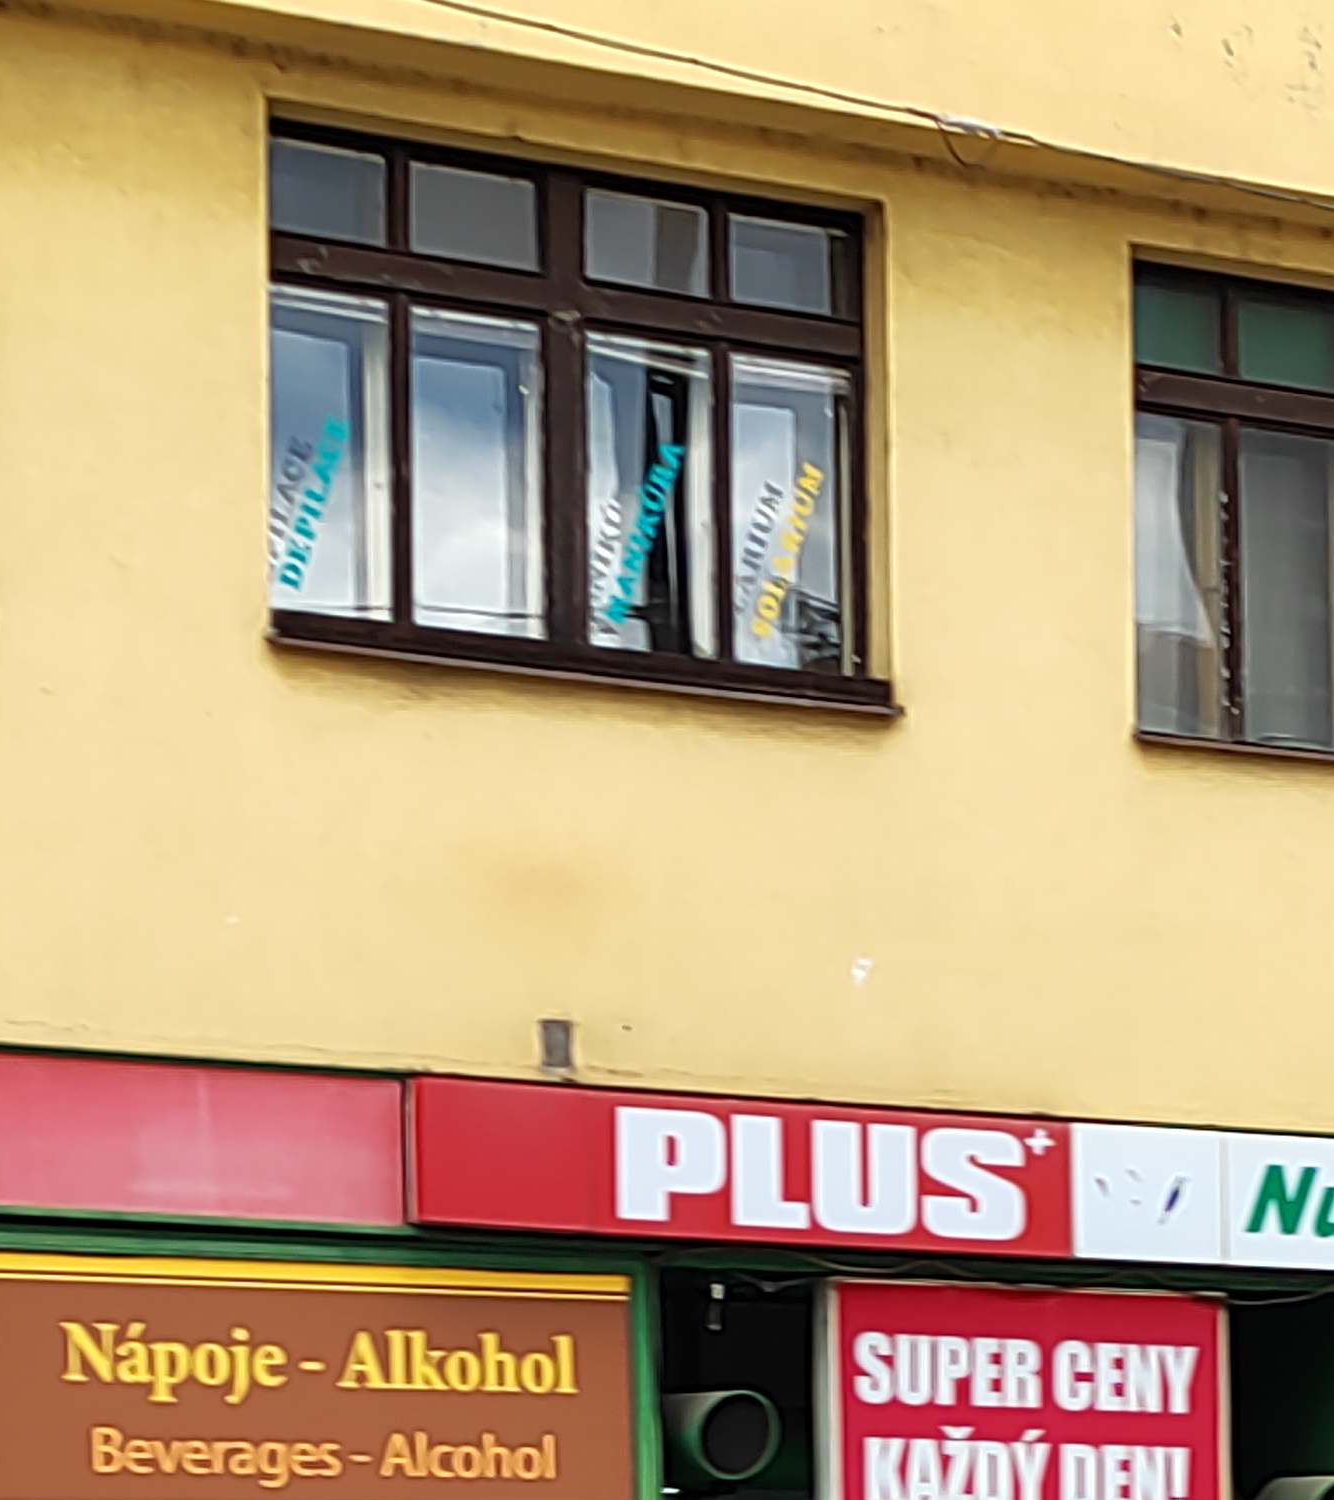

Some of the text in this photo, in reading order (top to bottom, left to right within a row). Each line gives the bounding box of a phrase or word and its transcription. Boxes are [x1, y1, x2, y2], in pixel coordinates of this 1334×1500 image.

[60, 1321, 288, 1404] Nápoje
[336, 1328, 579, 1394] Alkohol
[853, 1331, 1199, 1414] SUPER CENY
[91, 1427, 344, 1488] Beverages
[380, 1431, 557, 1480] Alcohol
